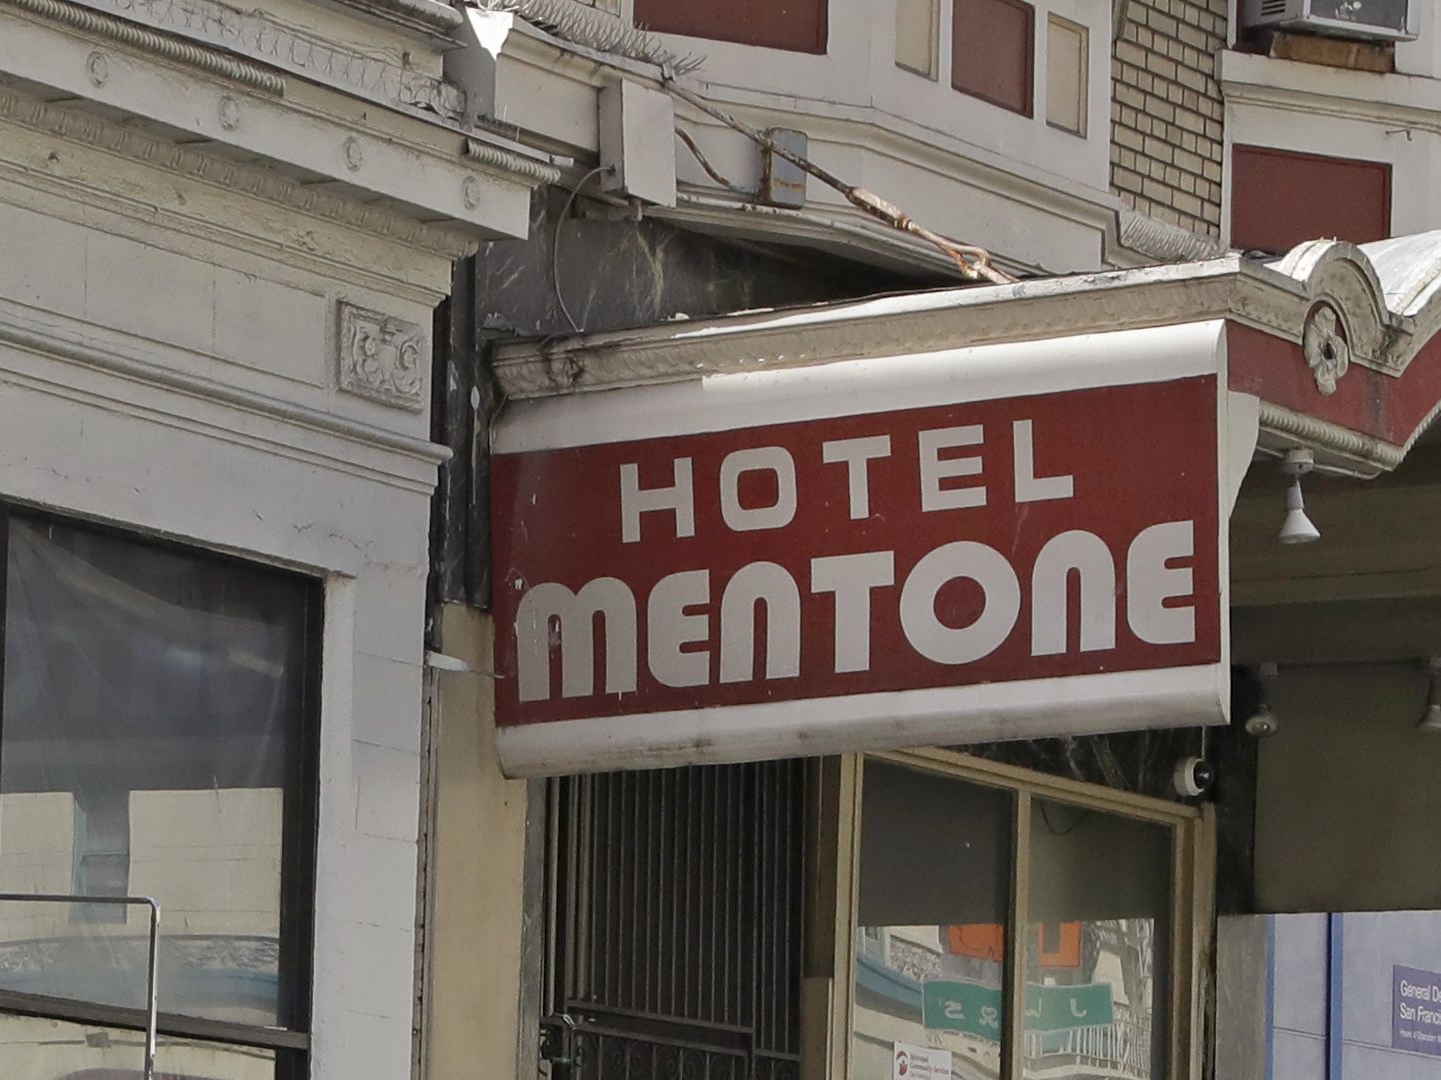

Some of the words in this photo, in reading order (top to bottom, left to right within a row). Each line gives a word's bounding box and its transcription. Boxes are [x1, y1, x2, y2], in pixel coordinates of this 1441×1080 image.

[620, 419, 1073, 543] HOTEL
[517, 520, 1196, 702] MENTONE
[1400, 979, 1431, 1001] General
[1400, 1002, 1416, 1020] San
